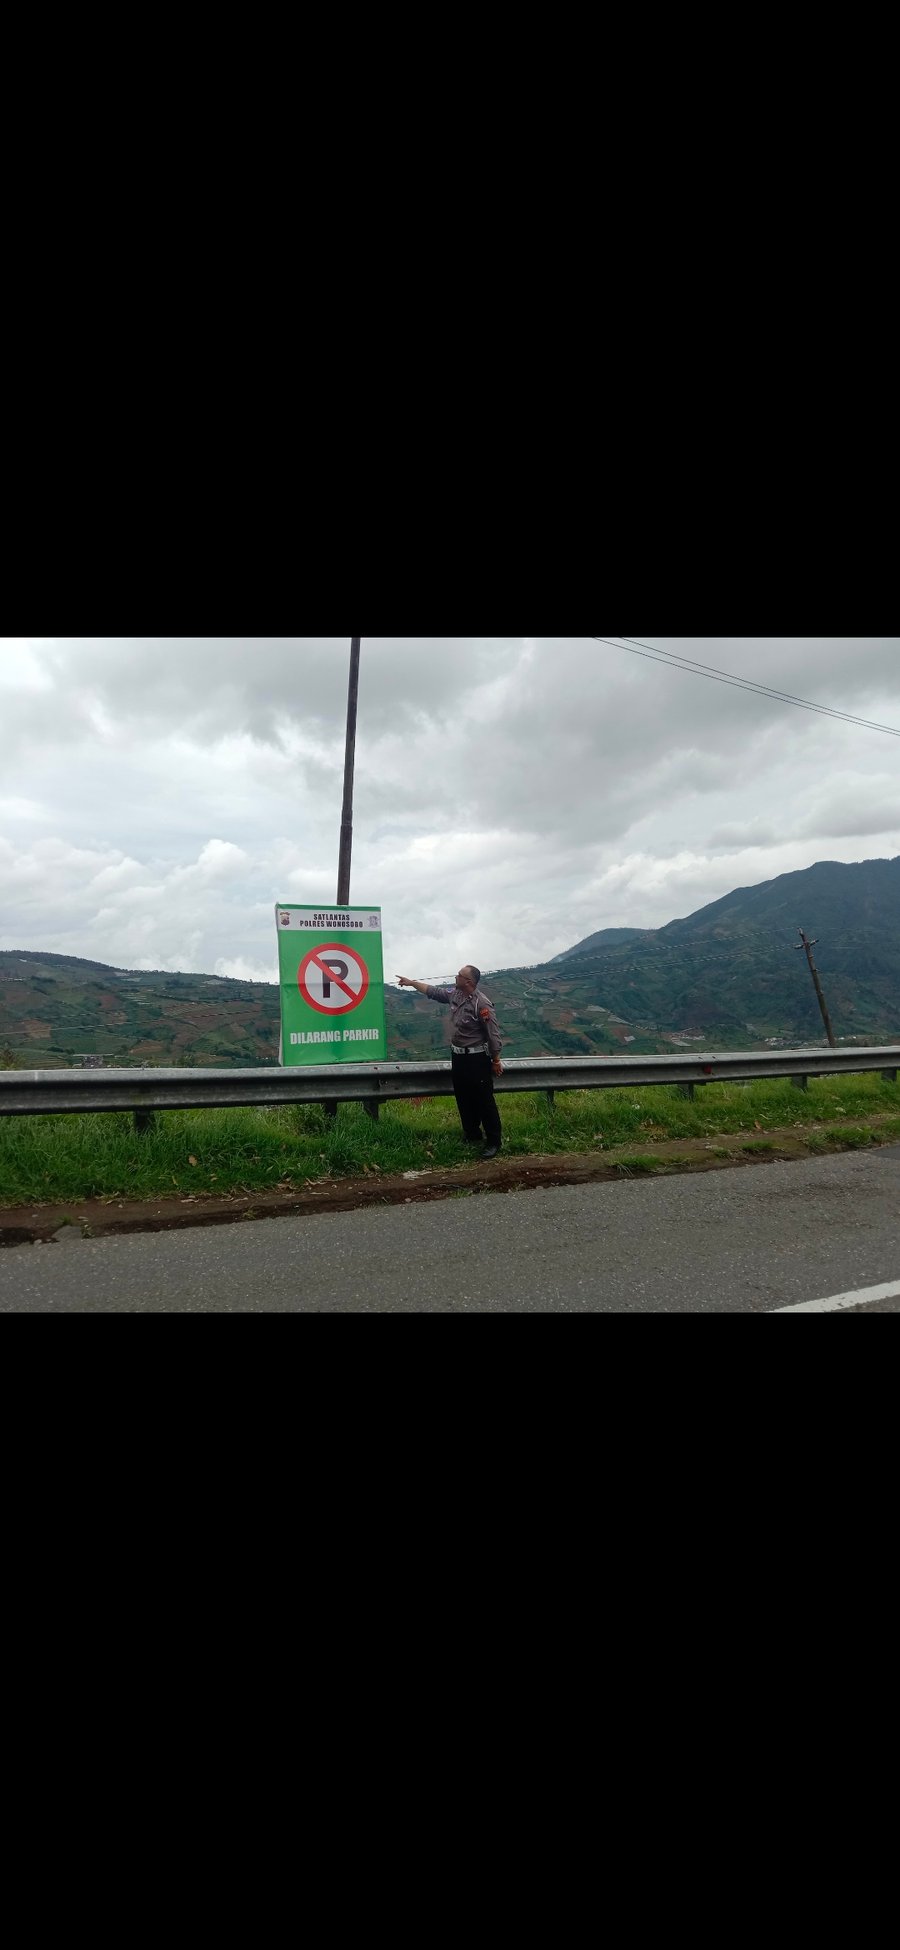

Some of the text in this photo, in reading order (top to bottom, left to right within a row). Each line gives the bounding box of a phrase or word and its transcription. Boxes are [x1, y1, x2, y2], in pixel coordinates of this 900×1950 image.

[313, 913, 350, 921] SATLANTAS
[322, 959, 349, 998] P
[290, 1028, 379, 1044] DILARANG PARKIR
